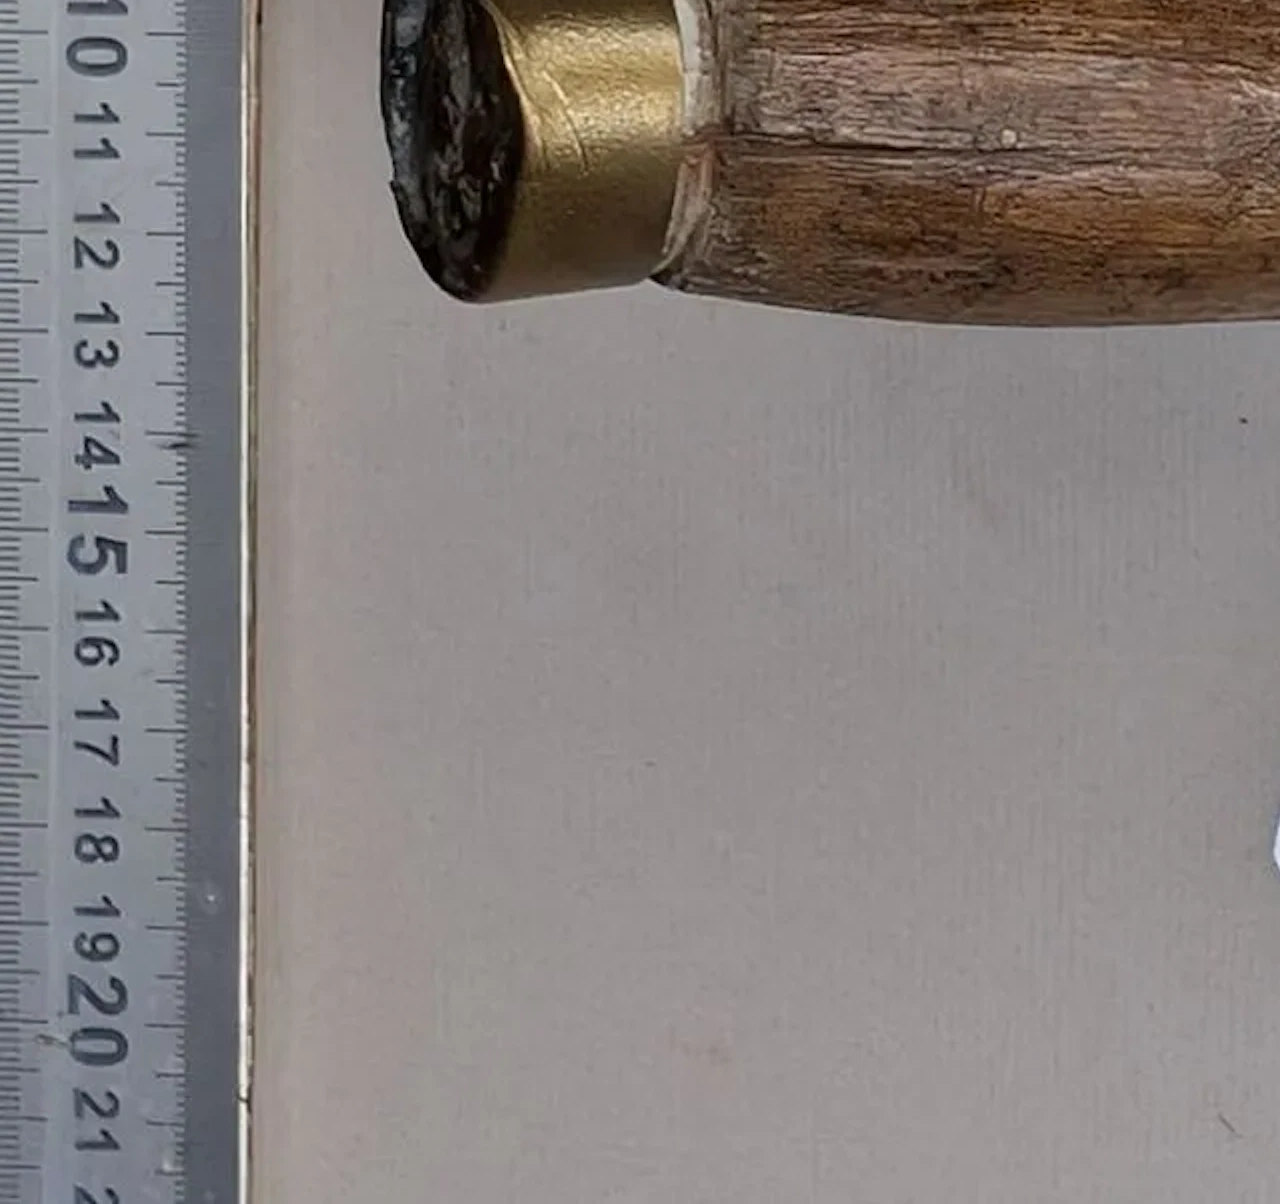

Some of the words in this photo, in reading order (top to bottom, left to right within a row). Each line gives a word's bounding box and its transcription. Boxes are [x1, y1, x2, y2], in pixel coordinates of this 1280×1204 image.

[73, 102, 121, 160] 11
[73, 202, 121, 270] 12
[73, 301, 120, 369] 13
[73, 401, 121, 471] 14
[66, 484, 129, 575] 15
[73, 599, 121, 667] 16
[73, 698, 121, 767] 17
[74, 796, 121, 864] 18
[73, 895, 122, 963] 19
[67, 974, 129, 1067] 20
[72, 1088, 121, 1151] 21
